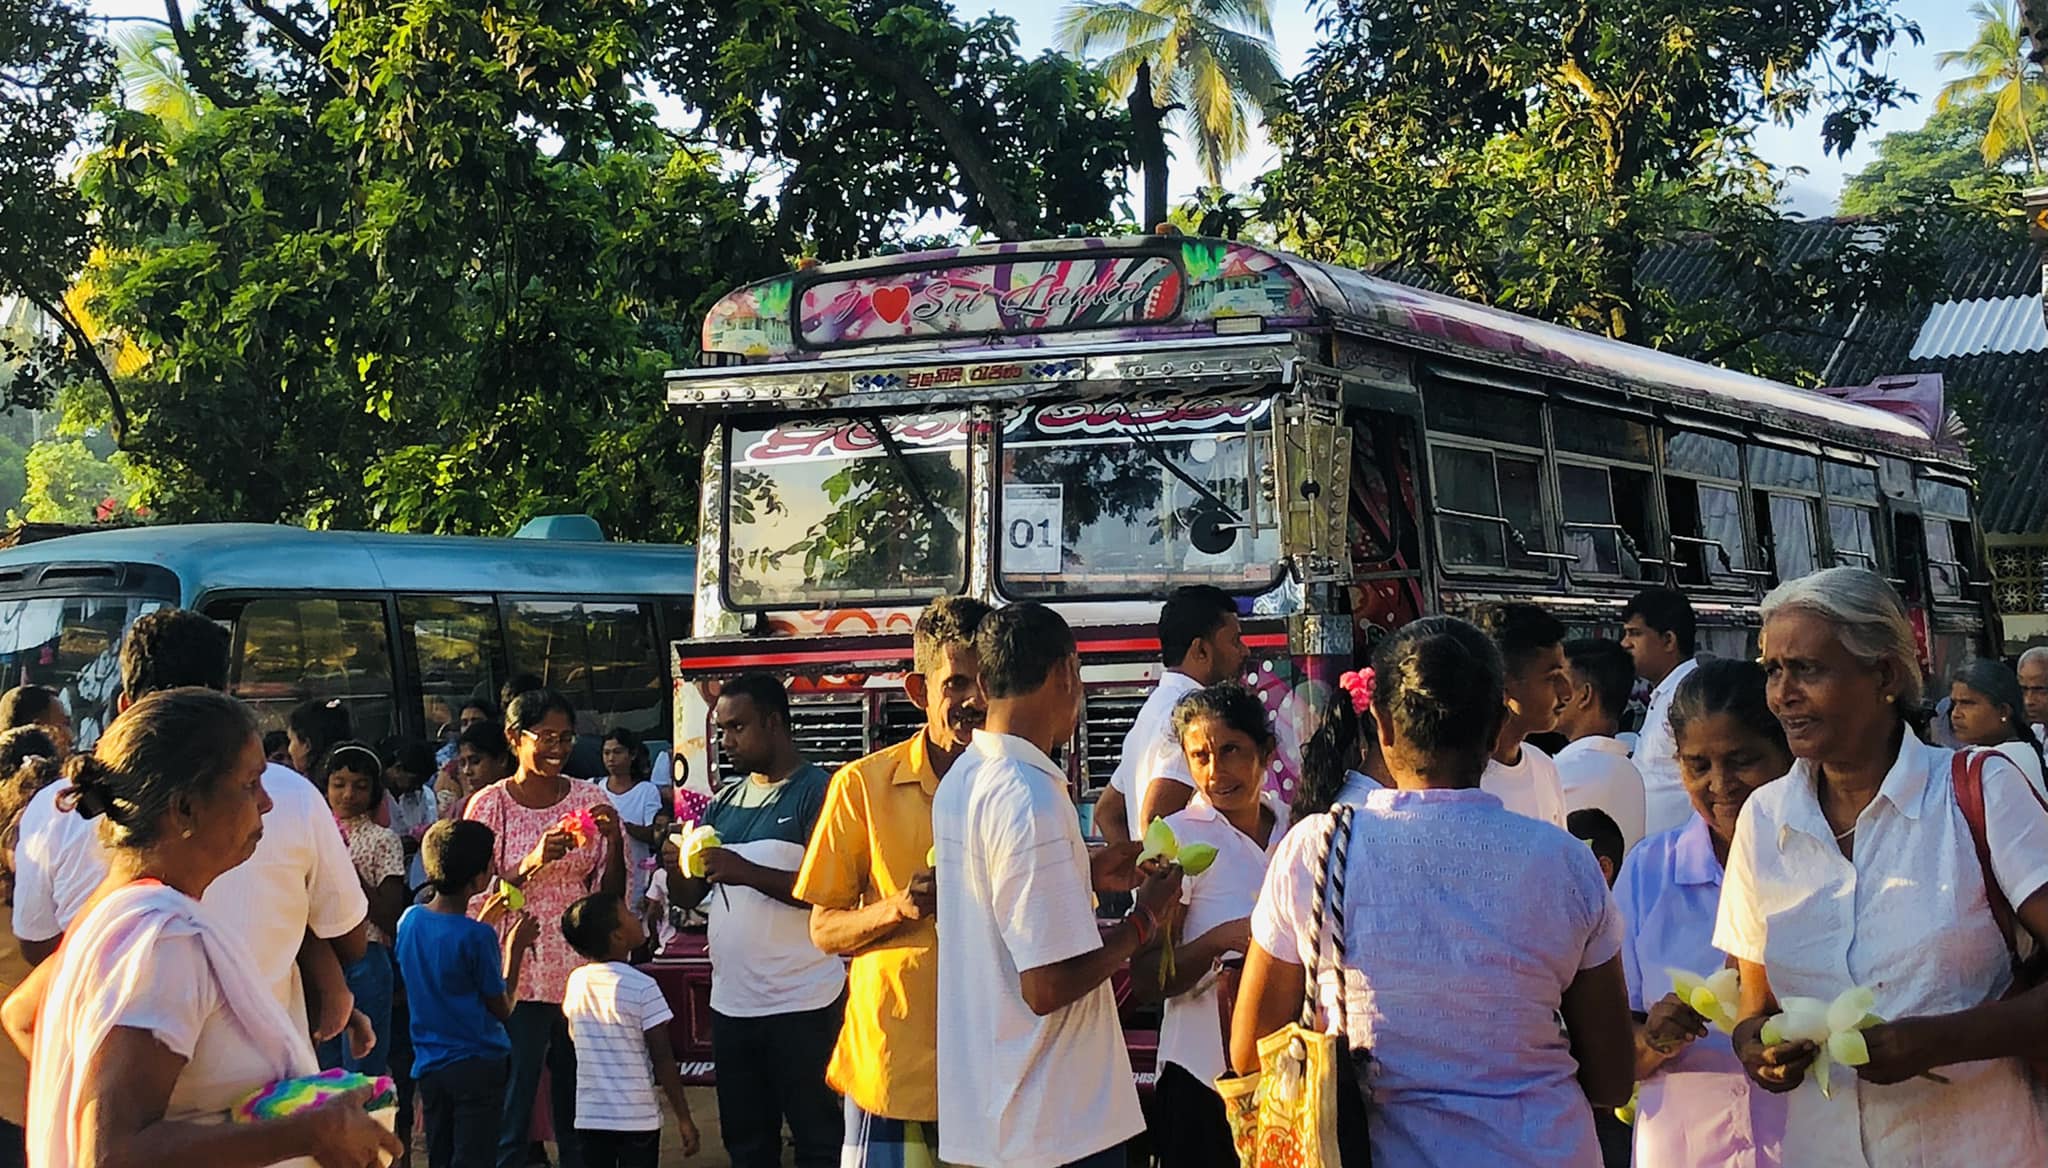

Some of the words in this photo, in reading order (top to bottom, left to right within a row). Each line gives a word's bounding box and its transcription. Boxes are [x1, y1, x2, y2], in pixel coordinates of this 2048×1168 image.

[912, 279, 985, 319] Sri
[1001, 270, 1146, 317] Lanka
[1009, 518, 1053, 549] 01
